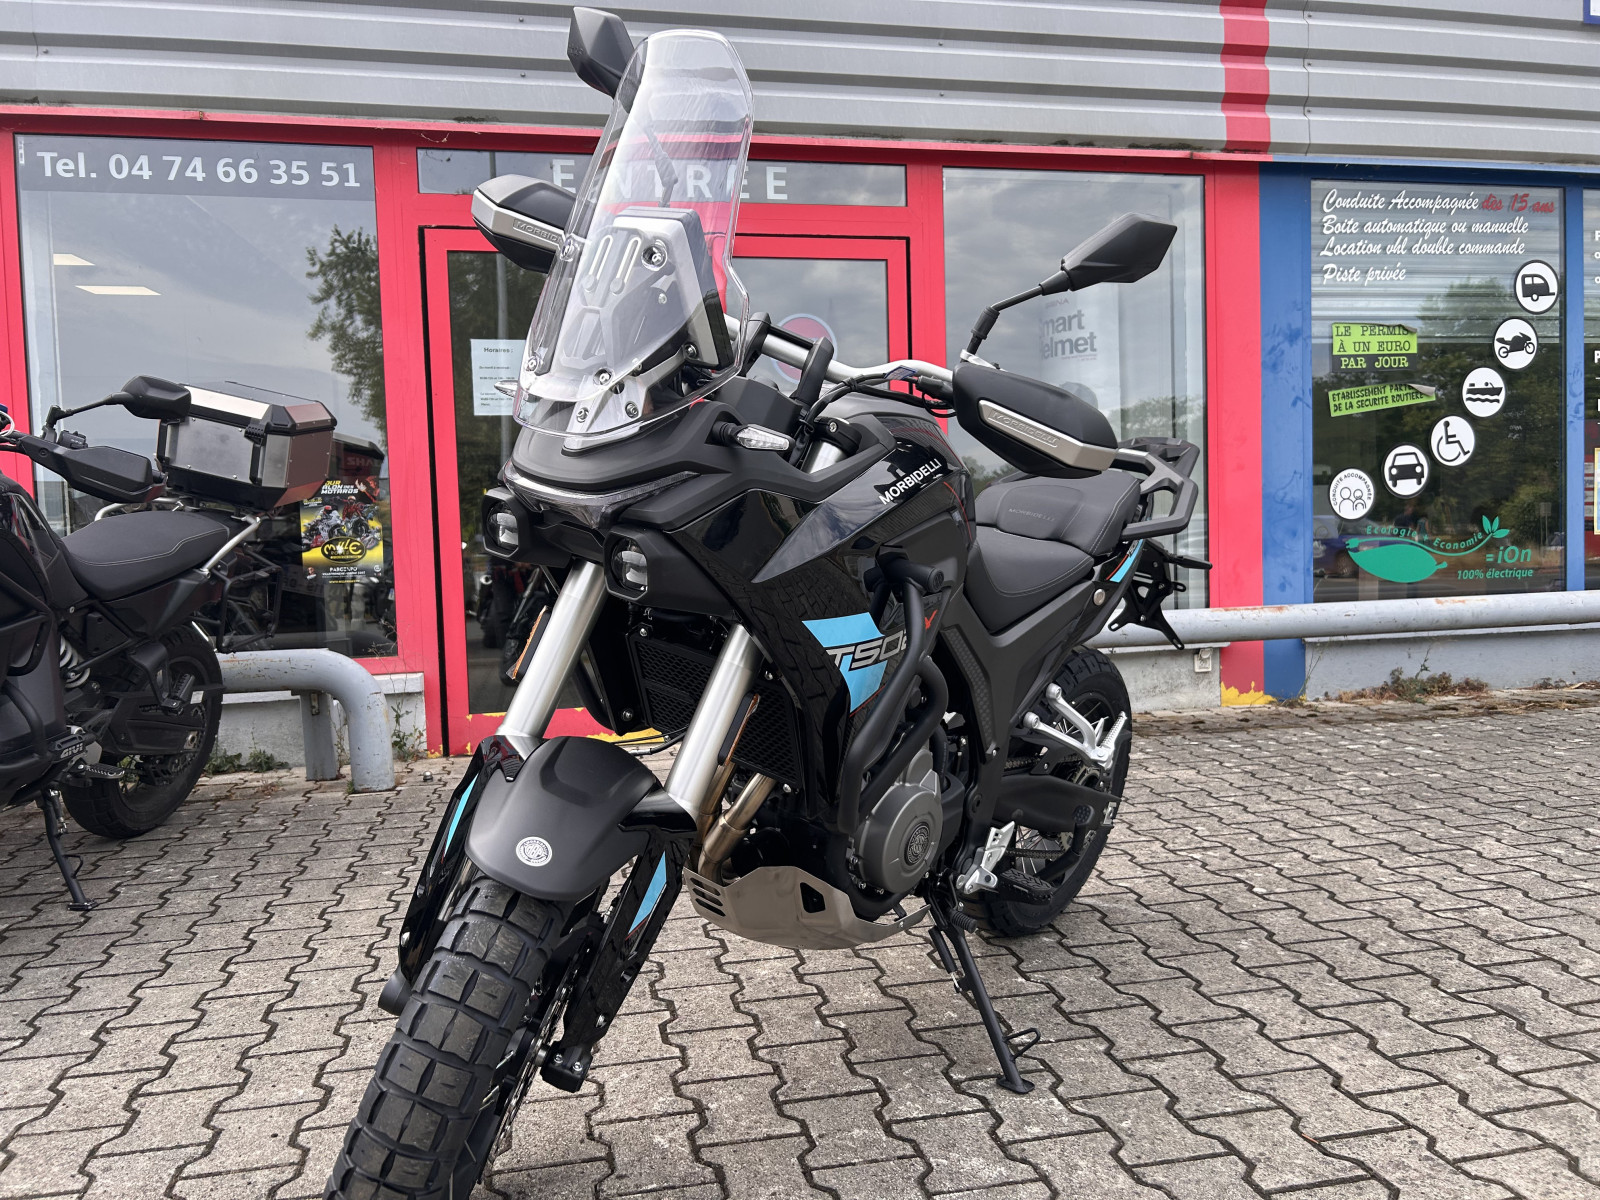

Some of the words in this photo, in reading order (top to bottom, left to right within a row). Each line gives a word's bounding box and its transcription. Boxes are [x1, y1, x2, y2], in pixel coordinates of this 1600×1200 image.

[36, 151, 97, 178] Tel.
[108, 153, 153, 180] 04
[162, 155, 206, 181] 74
[216, 157, 258, 183] 66
[268, 159, 310, 185] 35
[320, 161, 361, 187] 51
[1322, 188, 1386, 213] Conduite
[1387, 189, 1480, 215] Accompagnée
[1481, 193, 1503, 211] dès
[1510, 193, 1530, 212] 15
[1531, 201, 1555, 213] ans
[1322, 214, 1359, 235] Boite
[1363, 217, 1446, 240] automatique
[1451, 221, 1467, 233] ou
[1471, 216, 1529, 234] manuelle
[1319, 236, 1382, 256] Location
[1386, 235, 1408, 255] vhl
[1411, 235, 1454, 255] double
[1458, 237, 1525, 255] commande
[1322, 263, 1361, 285] Piste
[1364, 262, 1406, 286] privée
[1335, 325, 1351, 337] LE
[1360, 325, 1409, 337] PERMIS
[1337, 339, 1347, 352] À
[1353, 341, 1371, 352] UN
[1377, 340, 1411, 352] EURO
[1340, 357, 1367, 369] PAR
[1374, 356, 1409, 369] JOUR
[1332, 385, 1387, 402] ETABLISSEMENT
[1333, 403, 1343, 412] DE
[1345, 401, 1354, 411] LA
[879, 458, 942, 505] MORBIDELLI
[1332, 477, 1343, 506] CONDUITE
[1366, 525, 1417, 538] Ecologie
[1433, 531, 1483, 549] Economie
[1497, 546, 1532, 564] iOn
[1457, 569, 1484, 580] 100%
[1486, 567, 1534, 579] électrique
